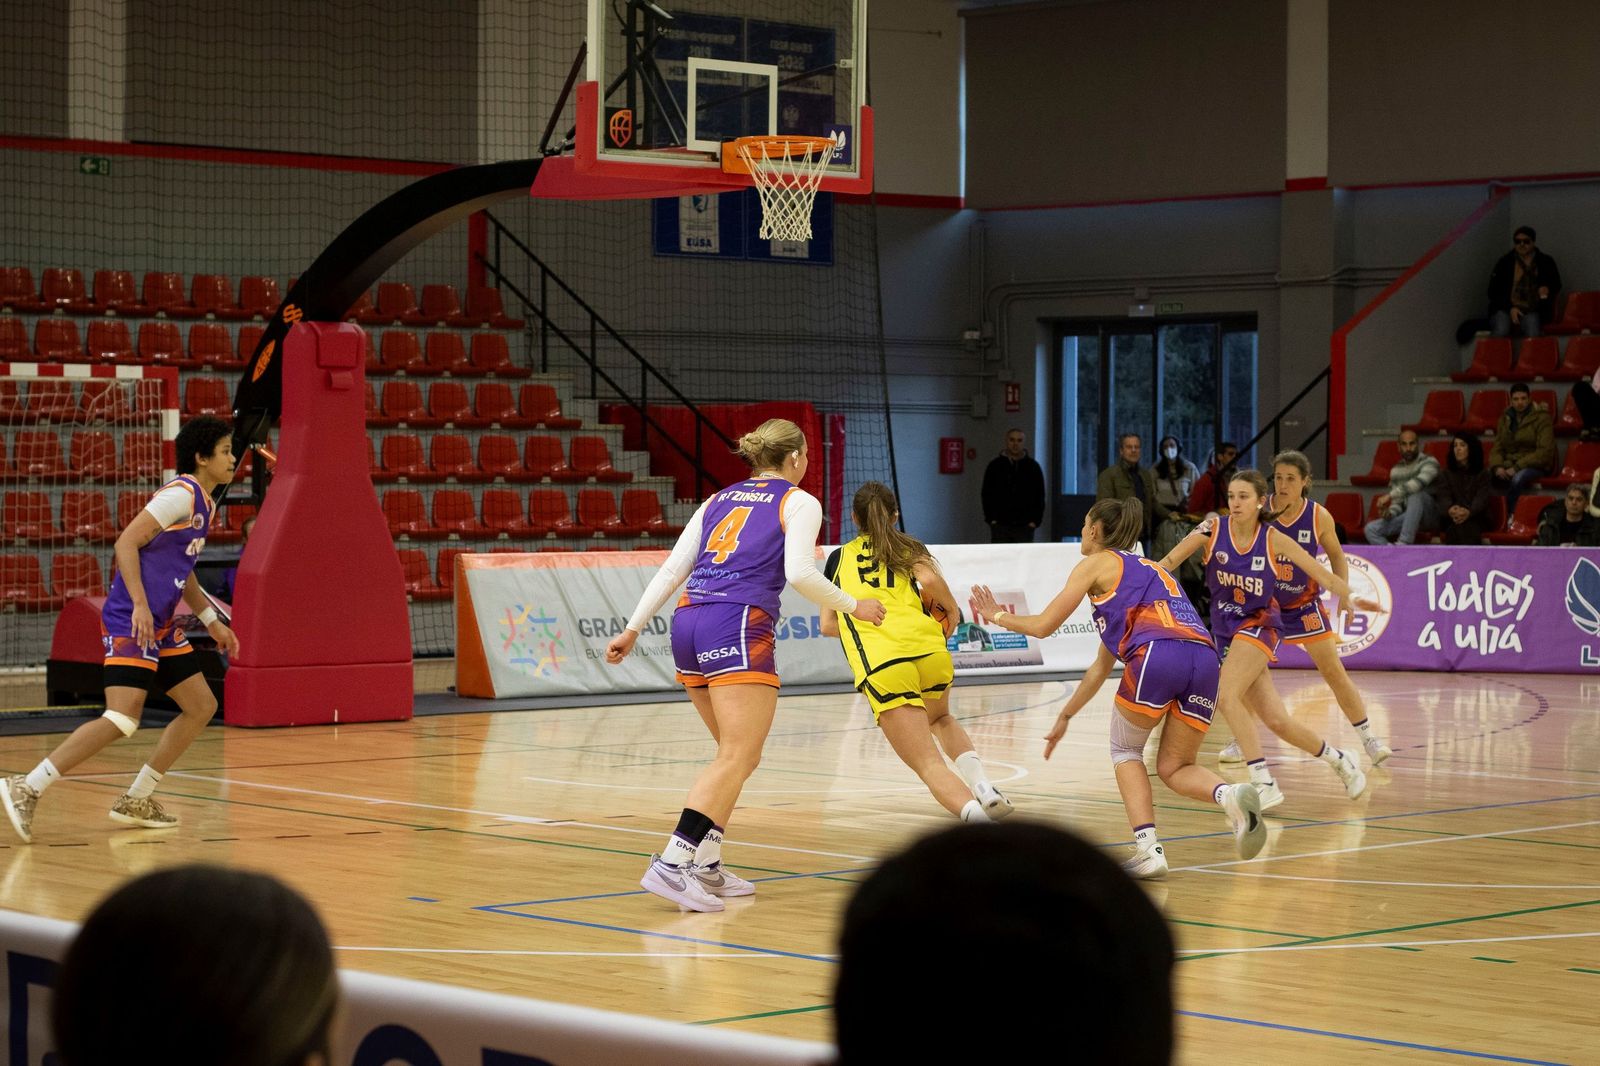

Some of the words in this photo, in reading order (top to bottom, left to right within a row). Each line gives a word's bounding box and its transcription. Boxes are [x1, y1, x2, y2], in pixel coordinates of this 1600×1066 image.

[704, 506, 754, 564] 4
[1216, 570, 1264, 597] GMASB
[1301, 612, 1322, 632] 16
[1417, 620, 1442, 651] a
[1580, 644, 1600, 667] L
